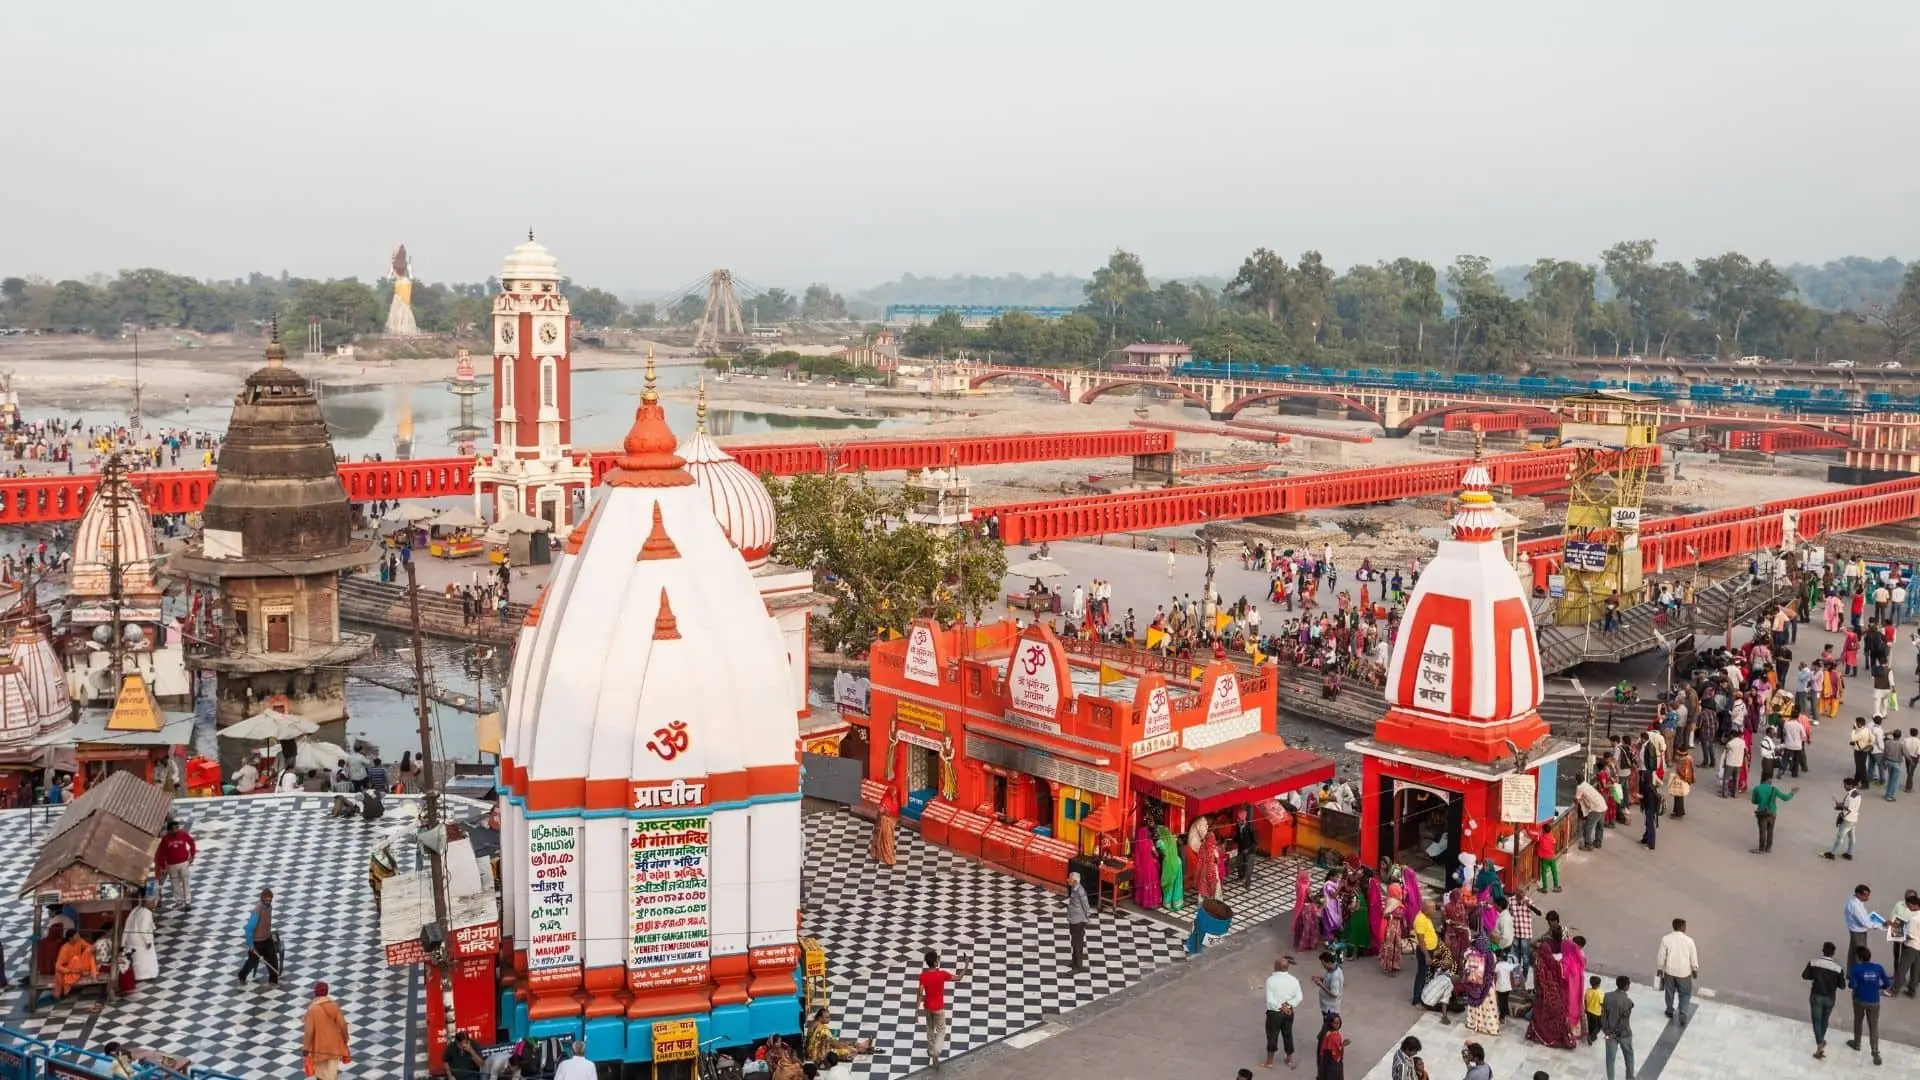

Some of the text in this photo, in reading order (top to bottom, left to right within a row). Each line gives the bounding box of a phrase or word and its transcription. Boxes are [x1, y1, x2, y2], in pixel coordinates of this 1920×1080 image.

[1616, 510, 1636, 520] 100
[634, 779, 705, 808] प्राचीन
[631, 830, 708, 848] श्री गंगा मन्दिर
[456, 926, 498, 942] श्री गंगा
[634, 929, 708, 945] ANCIENT GANGA TEMPLE
[458, 939, 496, 953] मन्दिर
[656, 1038, 694, 1053] दान पात्र
